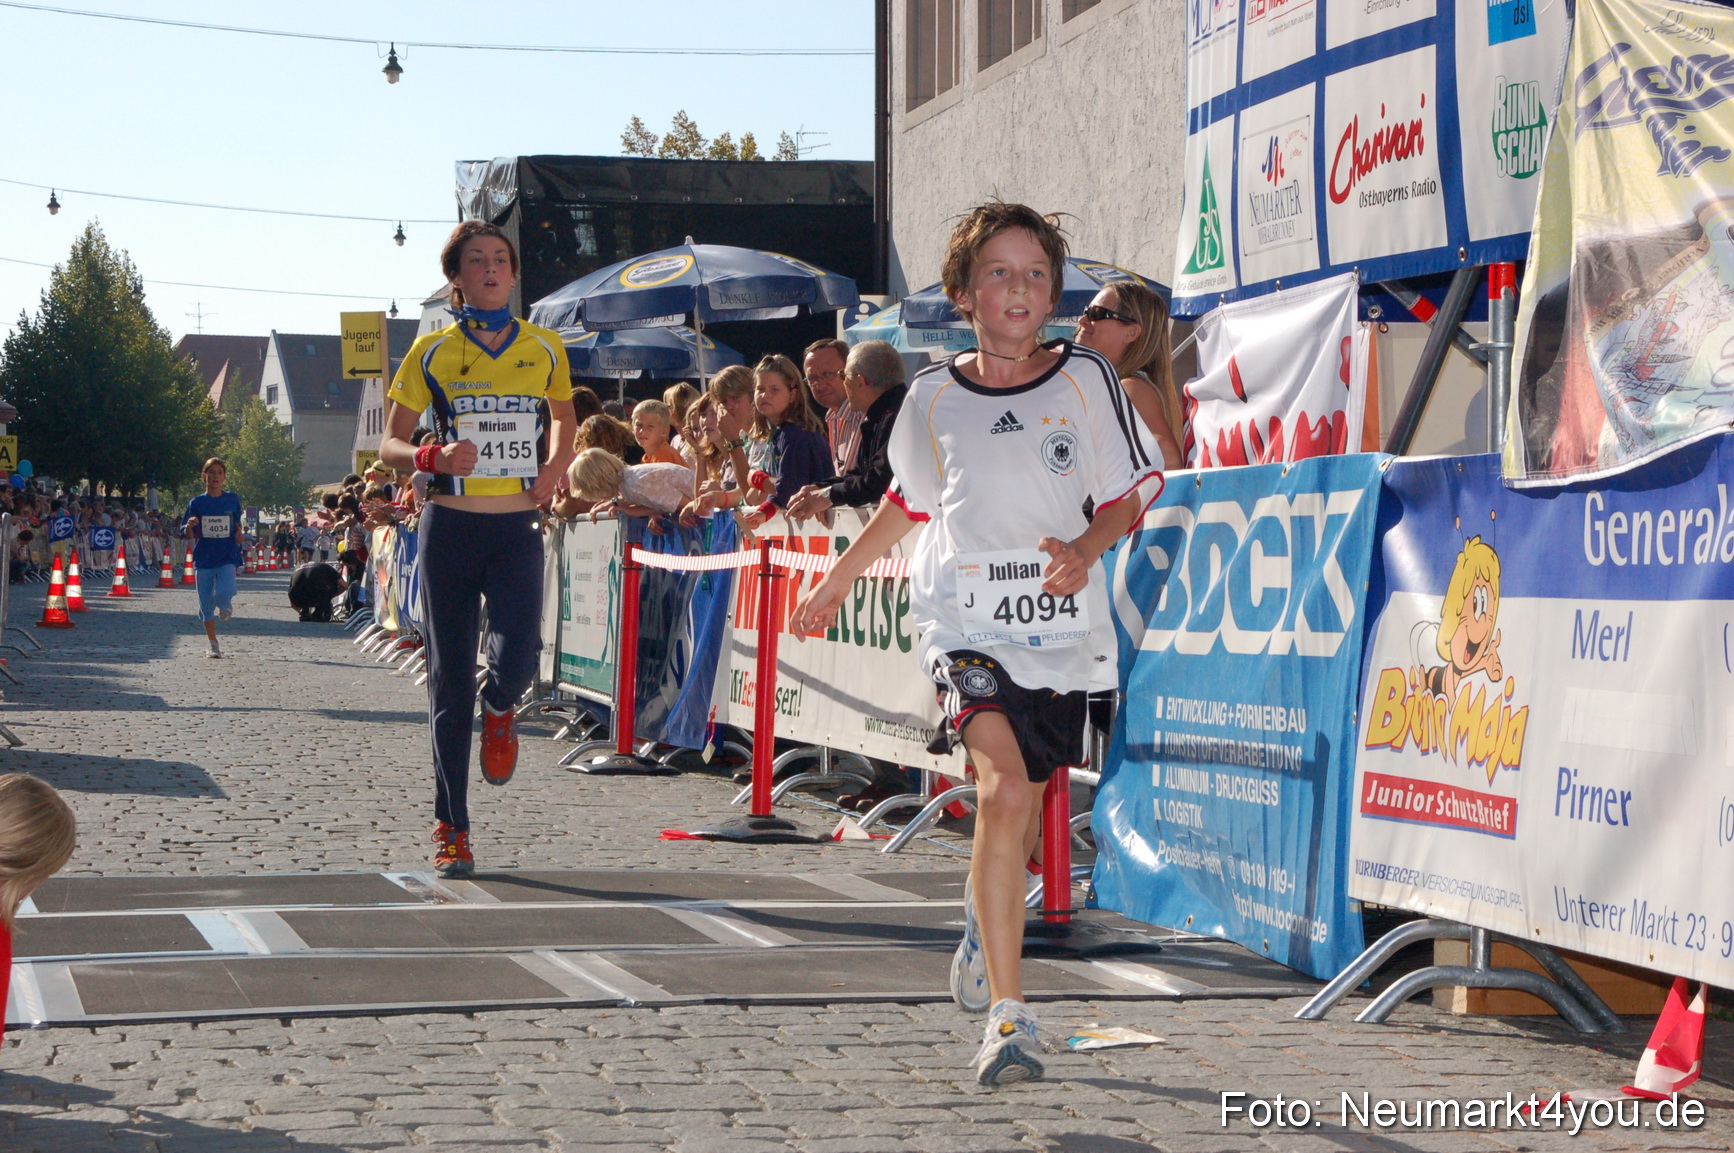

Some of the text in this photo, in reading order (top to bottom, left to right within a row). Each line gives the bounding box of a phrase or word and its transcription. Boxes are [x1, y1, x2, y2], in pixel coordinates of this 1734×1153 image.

[1494, 75, 1541, 132] RUND
[1329, 93, 1426, 204] Charivari
[1358, 177, 1437, 208] Ostbayerns Radio
[343, 329, 381, 342] Jugend
[922, 330, 977, 343] HELLE WO
[355, 342, 375, 353] lauf
[447, 381, 491, 391] TEAM
[452, 394, 541, 414] BOCK
[479, 418, 517, 433] Miriam
[990, 424, 1024, 435] adidas
[480, 441, 532, 460] 4155
[209, 525, 228, 533] 4034
[988, 561, 1041, 582] Julian
[1113, 488, 1364, 657] BOCK
[964, 592, 975, 608] J
[993, 591, 1079, 625] 4094
[1041, 630, 1088, 642] PFLEIDERER
[1571, 609, 1633, 662] Merl
[1450, 676, 1528, 787] Maja
[1165, 731, 1302, 771] KUNSTSTOFFVERARBEITUNG
[1555, 766, 1632, 826] Pirner
[1163, 799, 1203, 829] LOGISTIK
[1554, 886, 1626, 932] Unterer
[1630, 898, 1679, 946] Markt
[1685, 912, 1707, 951] 23
